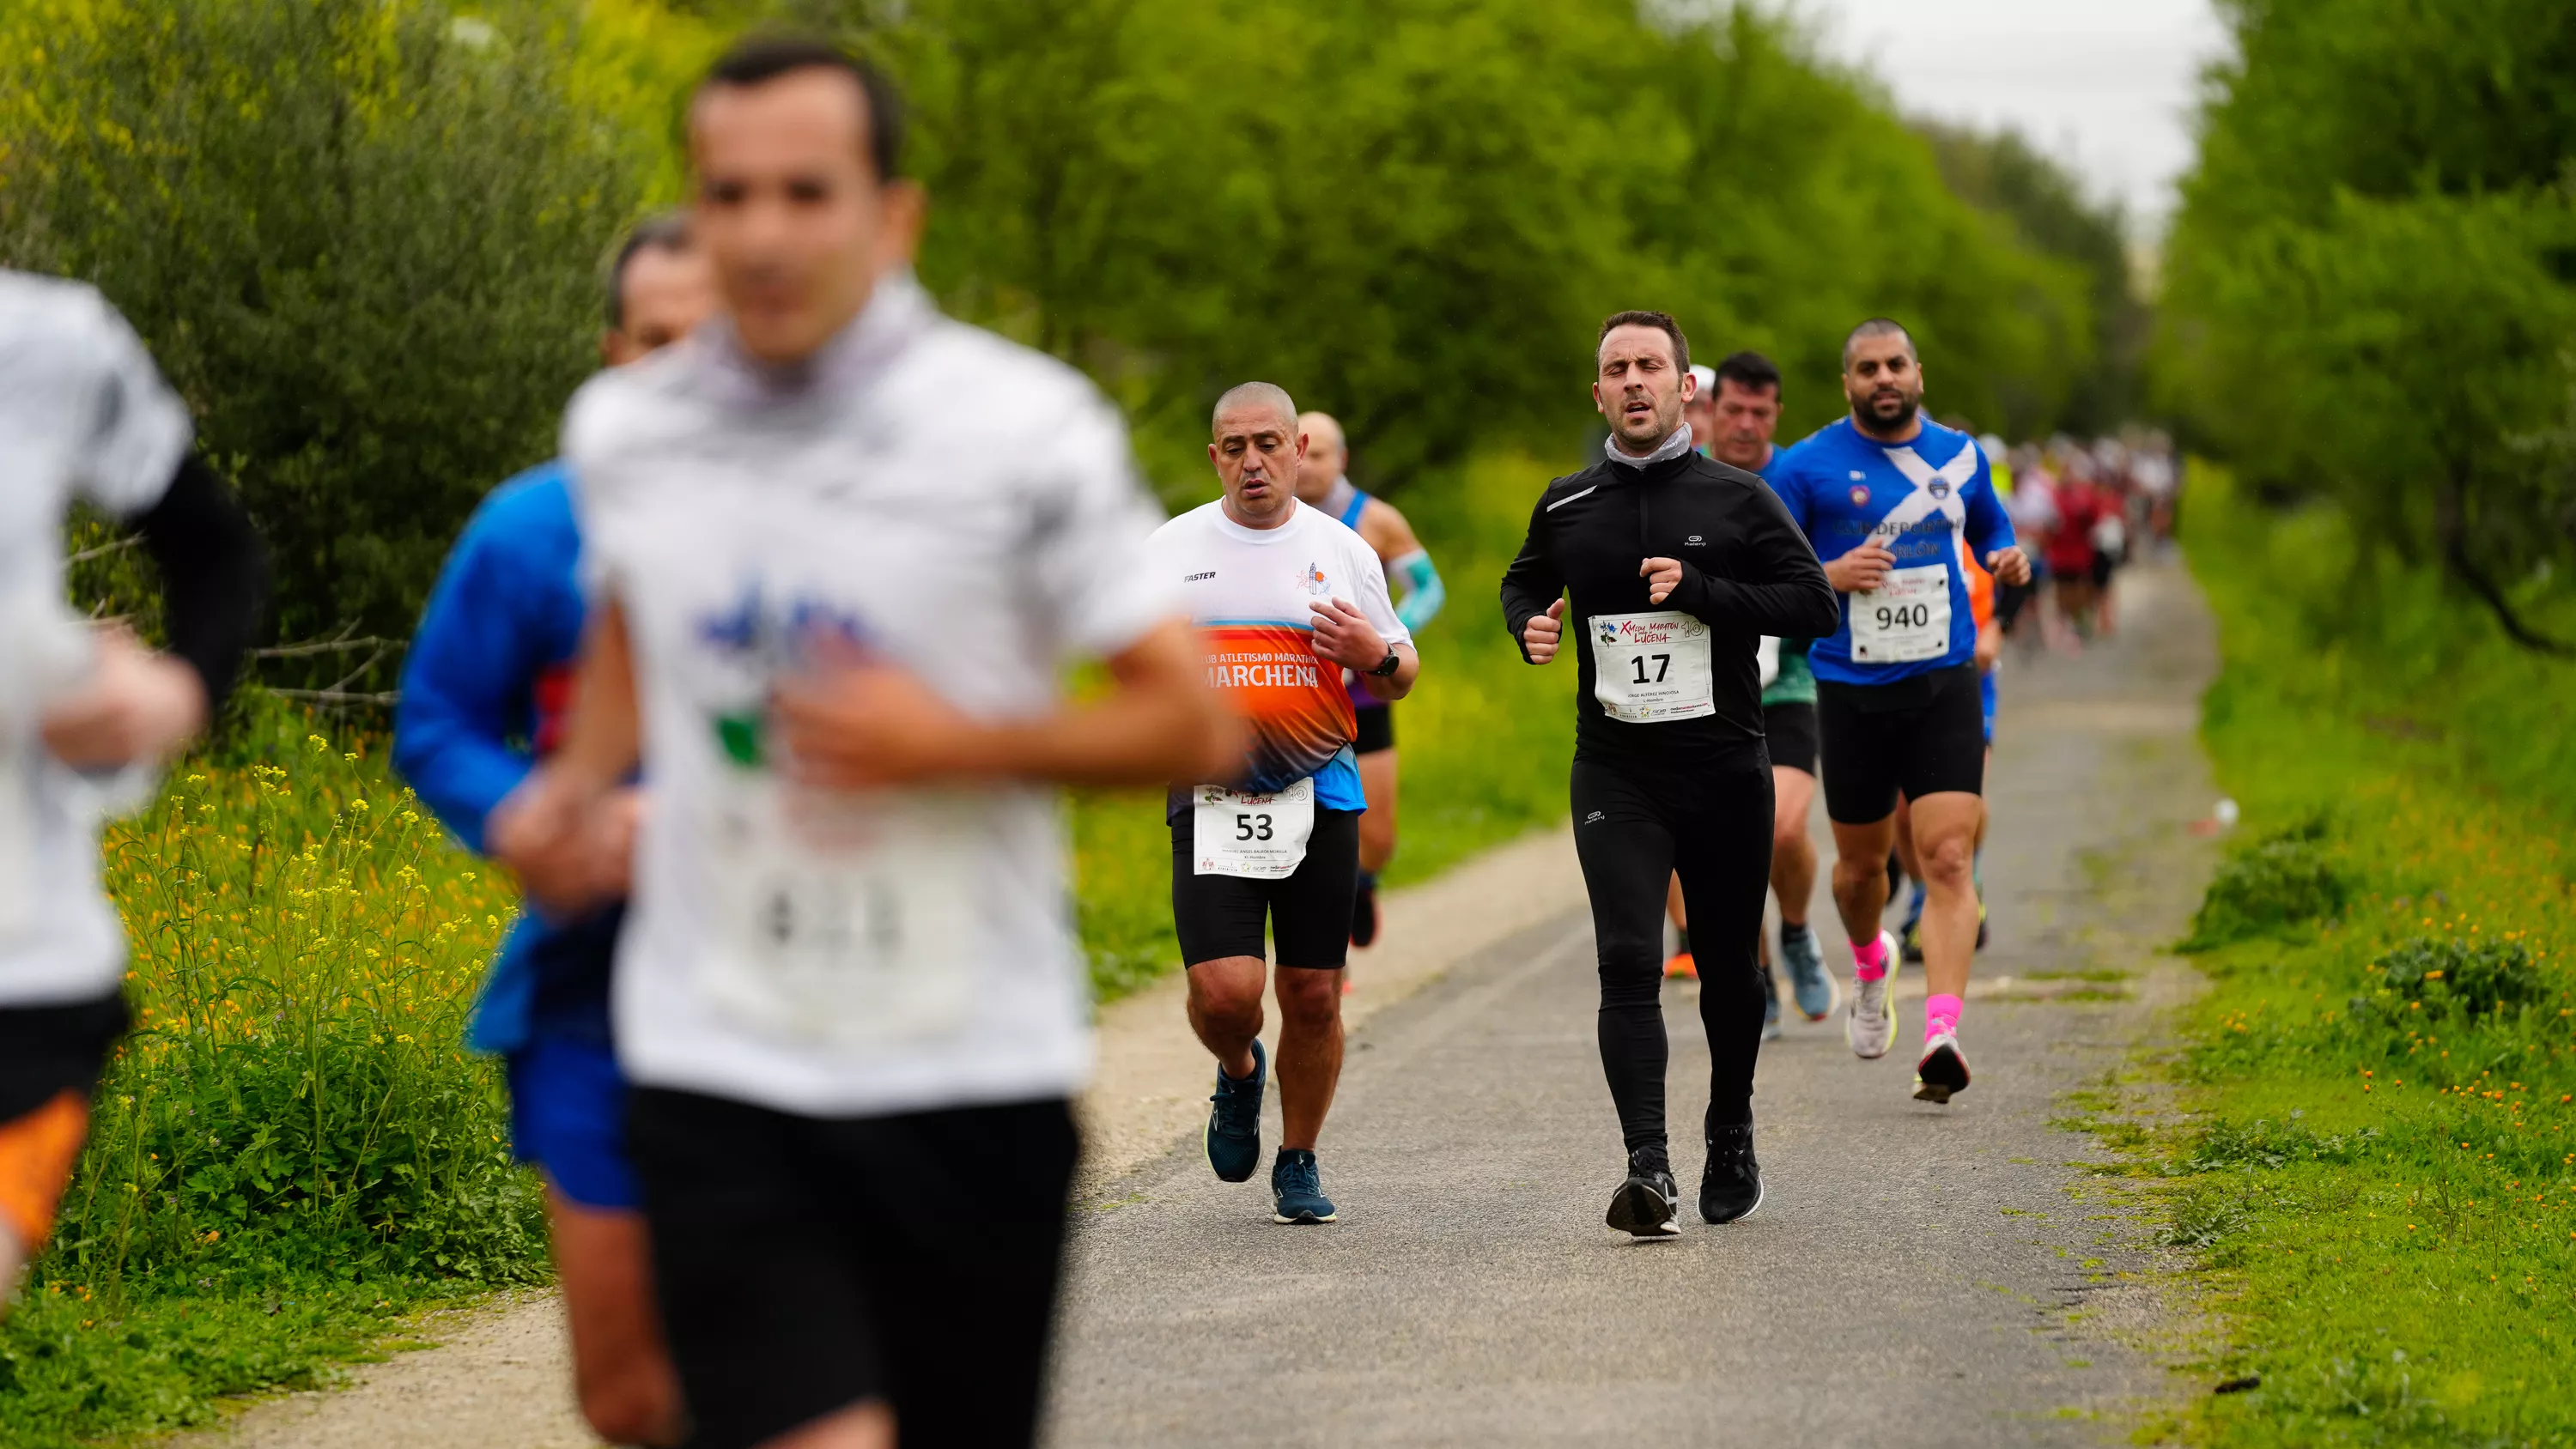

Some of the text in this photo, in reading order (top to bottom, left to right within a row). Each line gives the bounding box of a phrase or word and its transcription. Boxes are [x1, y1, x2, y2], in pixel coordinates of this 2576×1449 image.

[1184, 571, 1216, 583] FASTER
[1875, 603, 1929, 631] 940
[1634, 633, 1672, 644] LUCENA
[1219, 653, 1272, 663] ATLETISMO
[1204, 664, 1318, 688] MARCHENA
[1631, 653, 1671, 685] 17
[1240, 795, 1278, 805] LUCENA
[1236, 813, 1274, 841] 53
